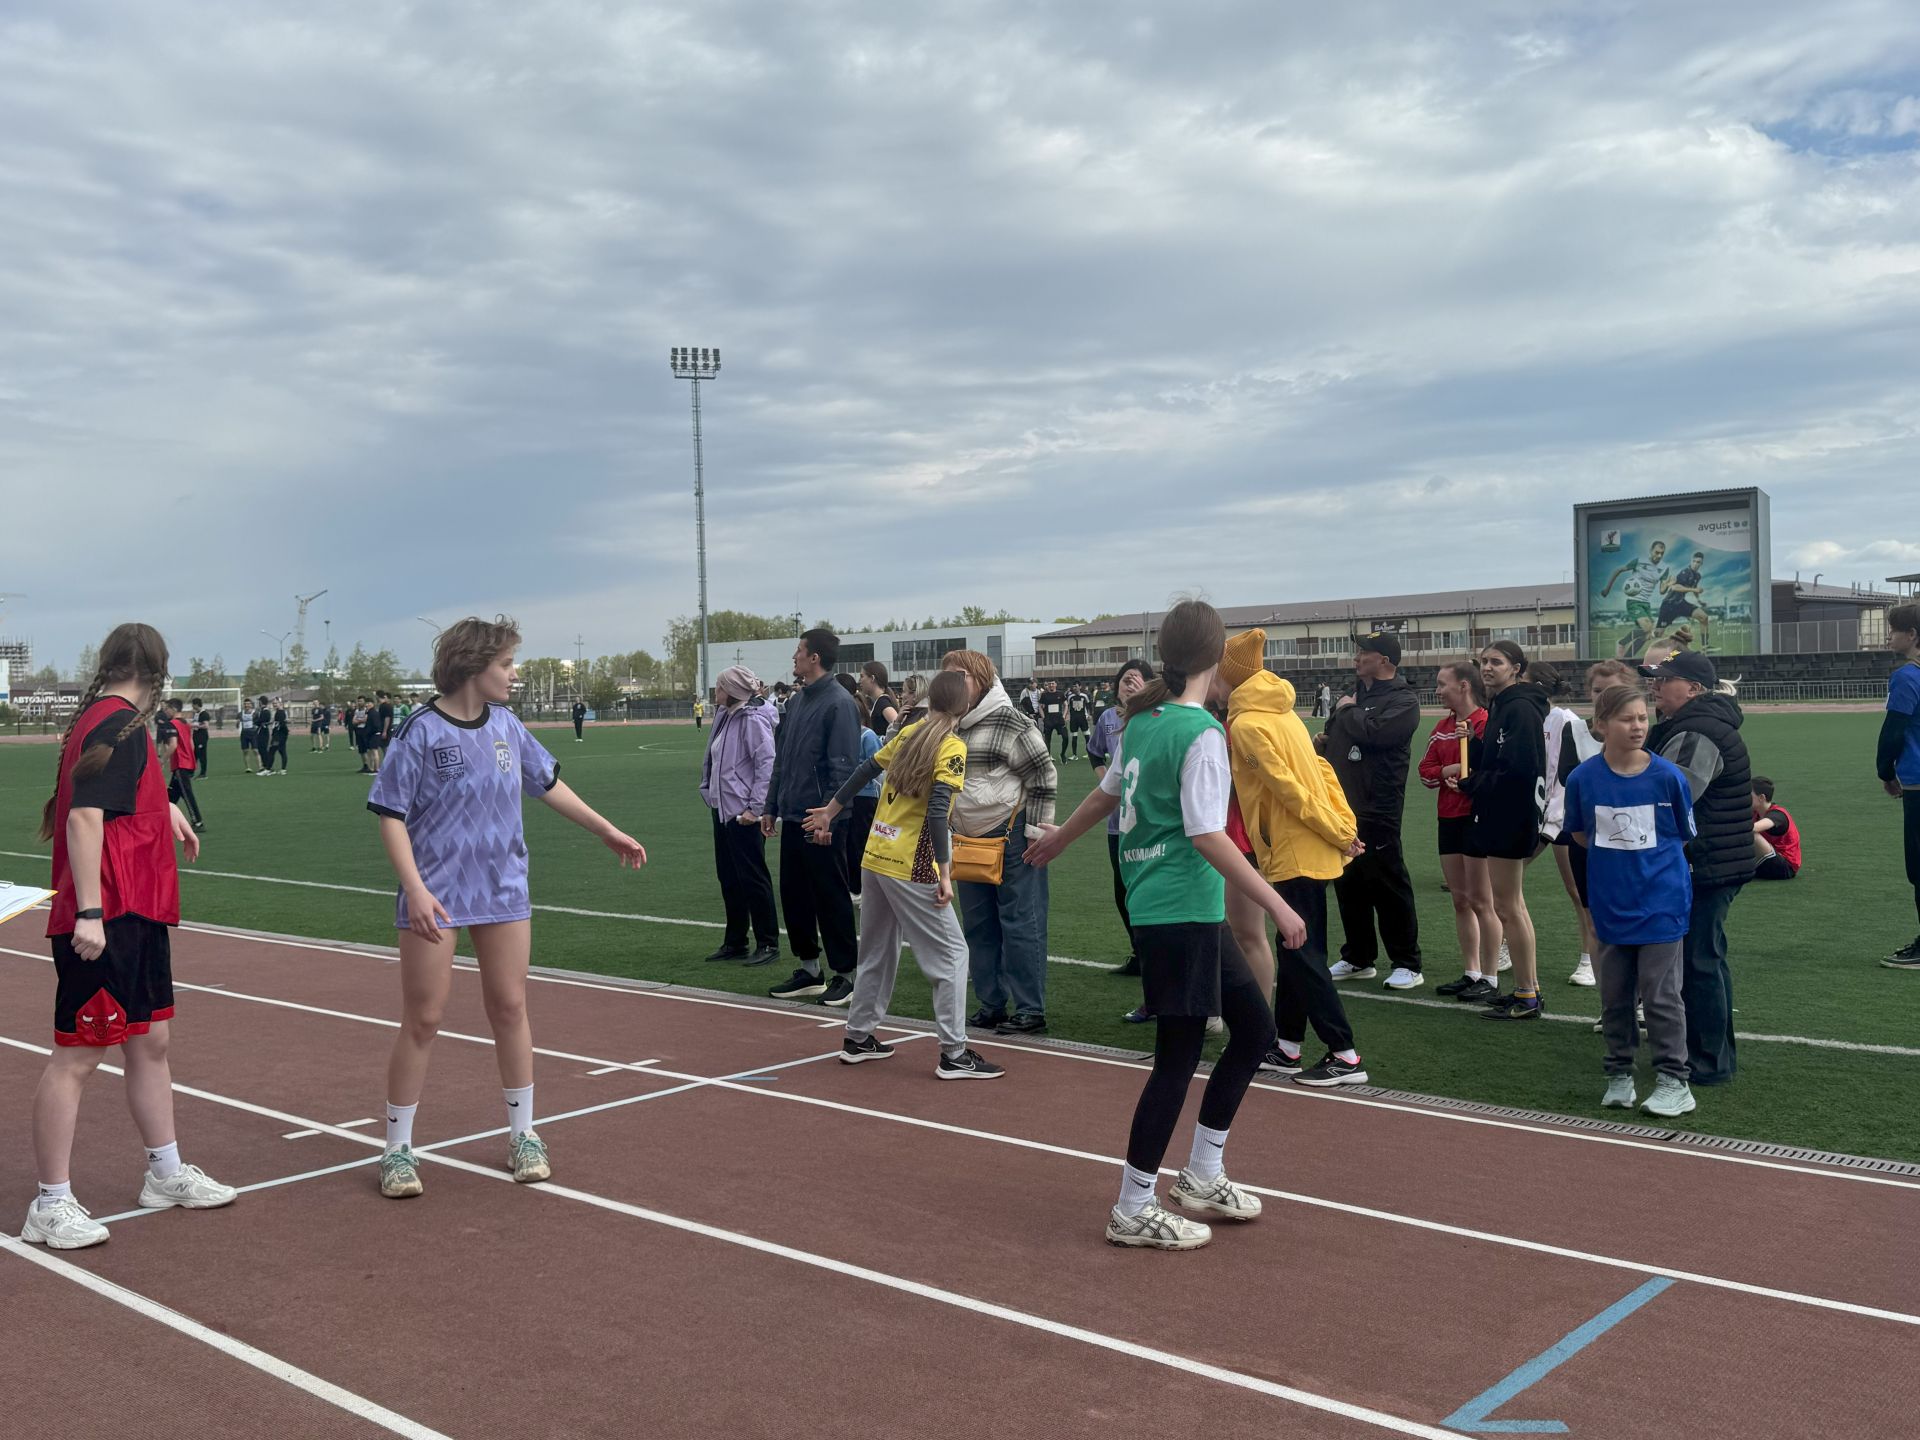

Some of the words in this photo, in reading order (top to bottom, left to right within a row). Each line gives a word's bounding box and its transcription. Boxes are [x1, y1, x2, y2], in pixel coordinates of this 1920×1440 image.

[1698, 521, 1732, 532] avgust
[13, 695, 79, 704] АВТОЗАПЧАСТИ
[439, 749, 458, 764] BS
